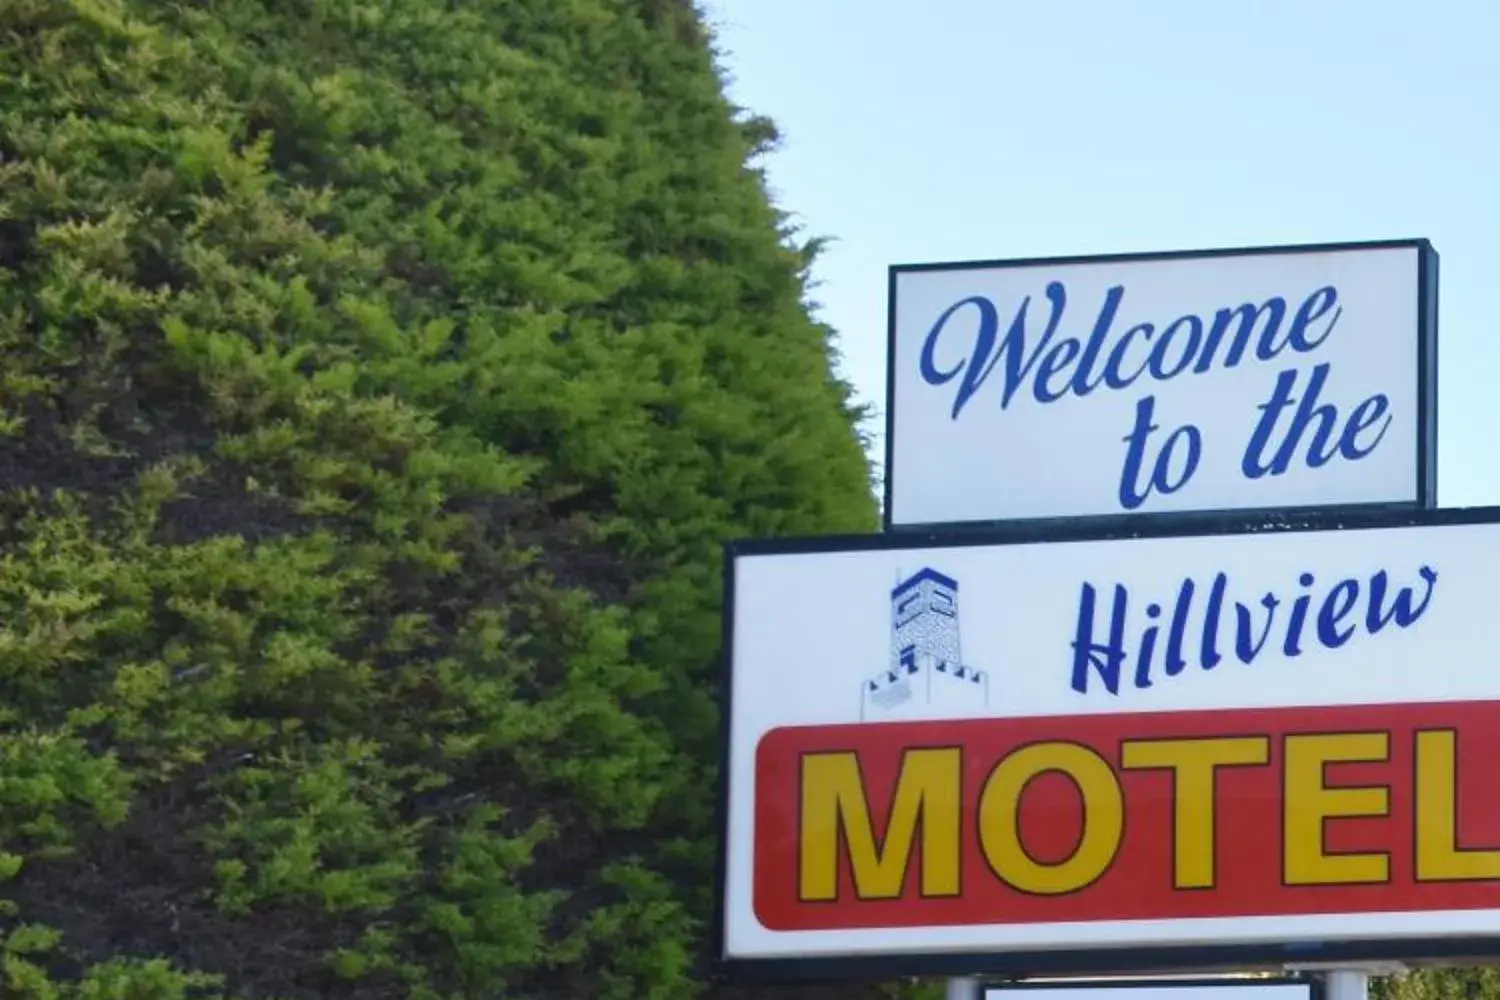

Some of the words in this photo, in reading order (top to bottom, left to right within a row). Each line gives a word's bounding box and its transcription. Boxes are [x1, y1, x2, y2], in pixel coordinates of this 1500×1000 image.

[919, 280, 1341, 420] Welcome
[1118, 396, 1201, 510] to
[1242, 363, 1393, 480] the
[1070, 564, 1439, 696] Hillview
